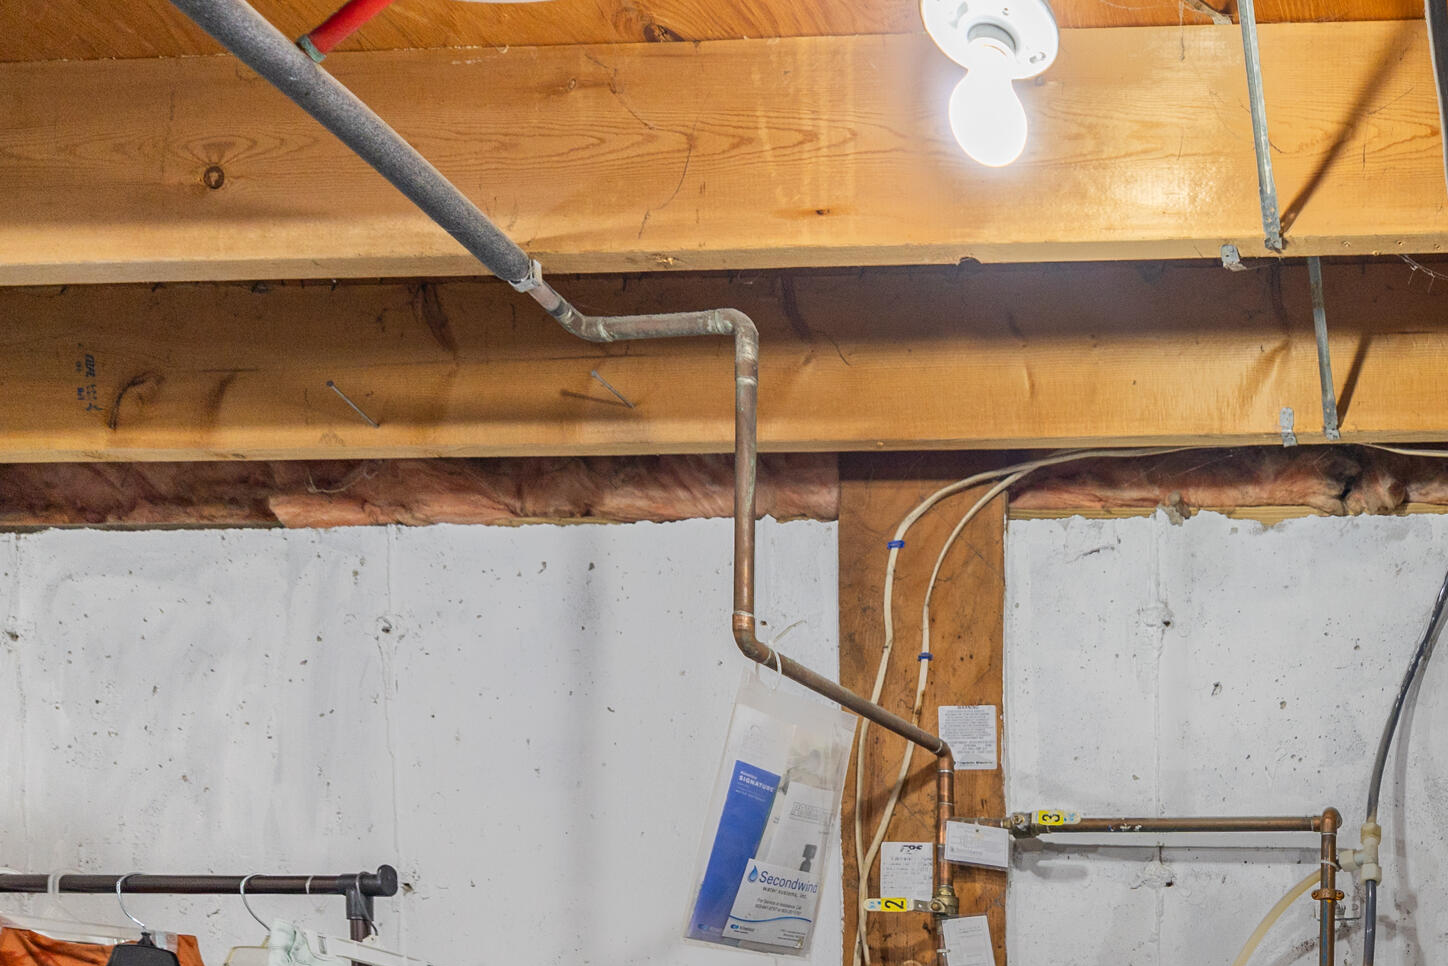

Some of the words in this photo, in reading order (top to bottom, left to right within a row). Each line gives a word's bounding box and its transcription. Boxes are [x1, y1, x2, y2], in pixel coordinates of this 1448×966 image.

[739, 775, 775, 793] SIGNATURE
[1042, 813, 1060, 823] 3
[885, 900, 904, 909] 2
